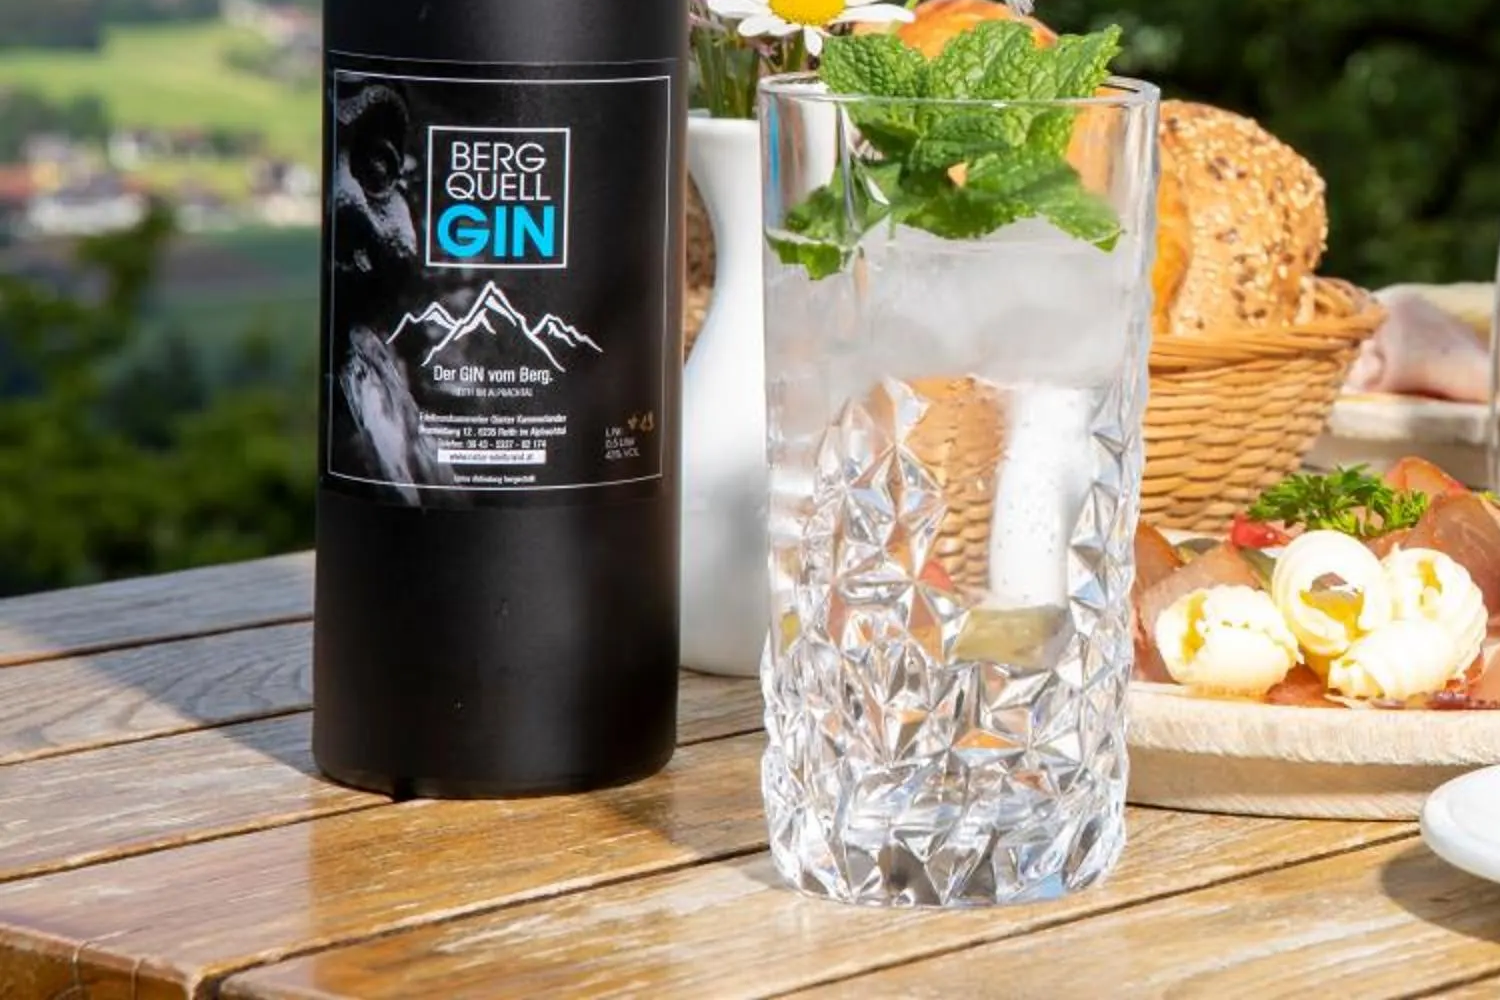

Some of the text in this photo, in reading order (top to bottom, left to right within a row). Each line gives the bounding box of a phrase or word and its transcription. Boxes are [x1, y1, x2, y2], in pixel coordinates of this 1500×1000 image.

[451, 140, 546, 172] BERG
[445, 172, 551, 201] QUELL
[437, 203, 554, 258] GIN
[433, 365, 553, 385] Der GIN vom Berg.
